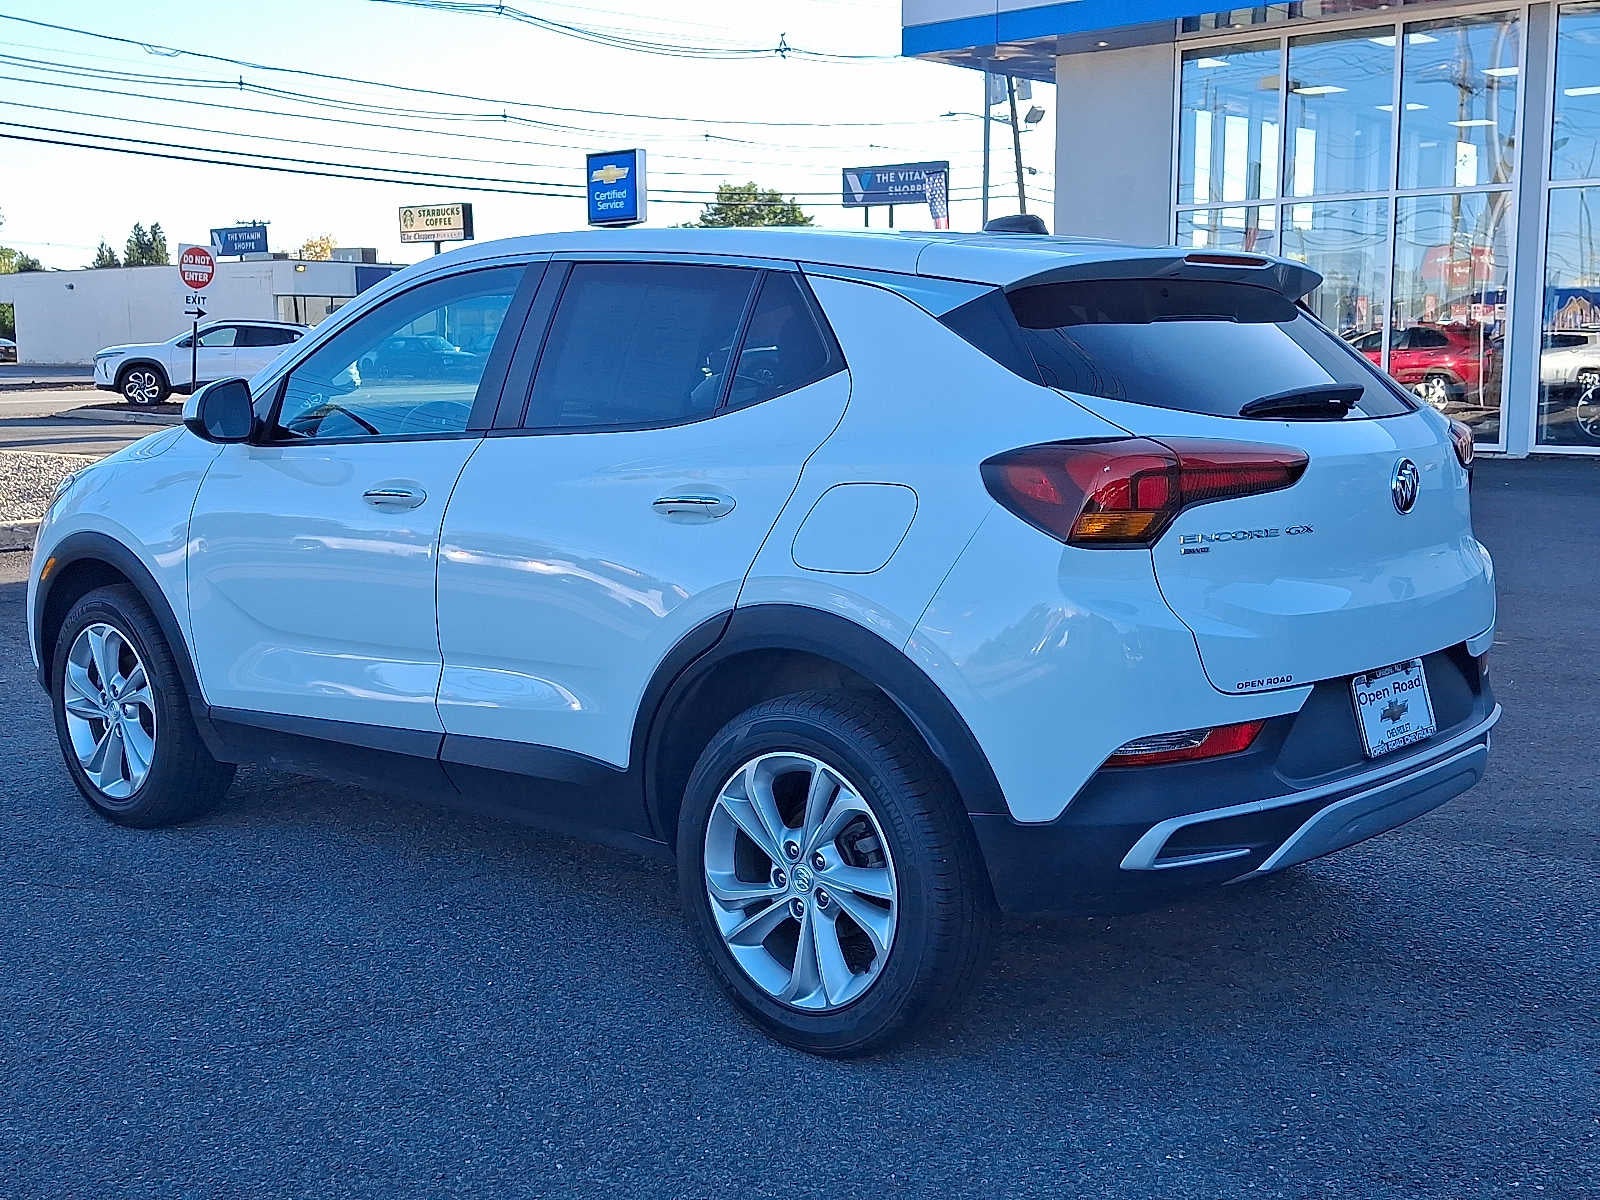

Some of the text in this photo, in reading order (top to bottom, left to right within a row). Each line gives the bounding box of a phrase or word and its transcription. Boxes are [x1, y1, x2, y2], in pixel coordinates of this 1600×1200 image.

[876, 173, 895, 184] THE
[594, 189, 627, 201] Certified
[597, 200, 625, 211] Service
[417, 207, 460, 217] STARBUCKS
[425, 217, 452, 227] COFFEE
[227, 232, 261, 241] THE VITAMIN
[183, 255, 211, 265] DO NOT
[184, 272, 209, 282] ENTER
[185, 295, 207, 305] EXIT
[1179, 523, 1314, 546] ENCORE GX
[1236, 674, 1293, 690] OPEN ROAD
[1358, 675, 1421, 706] Open Road
